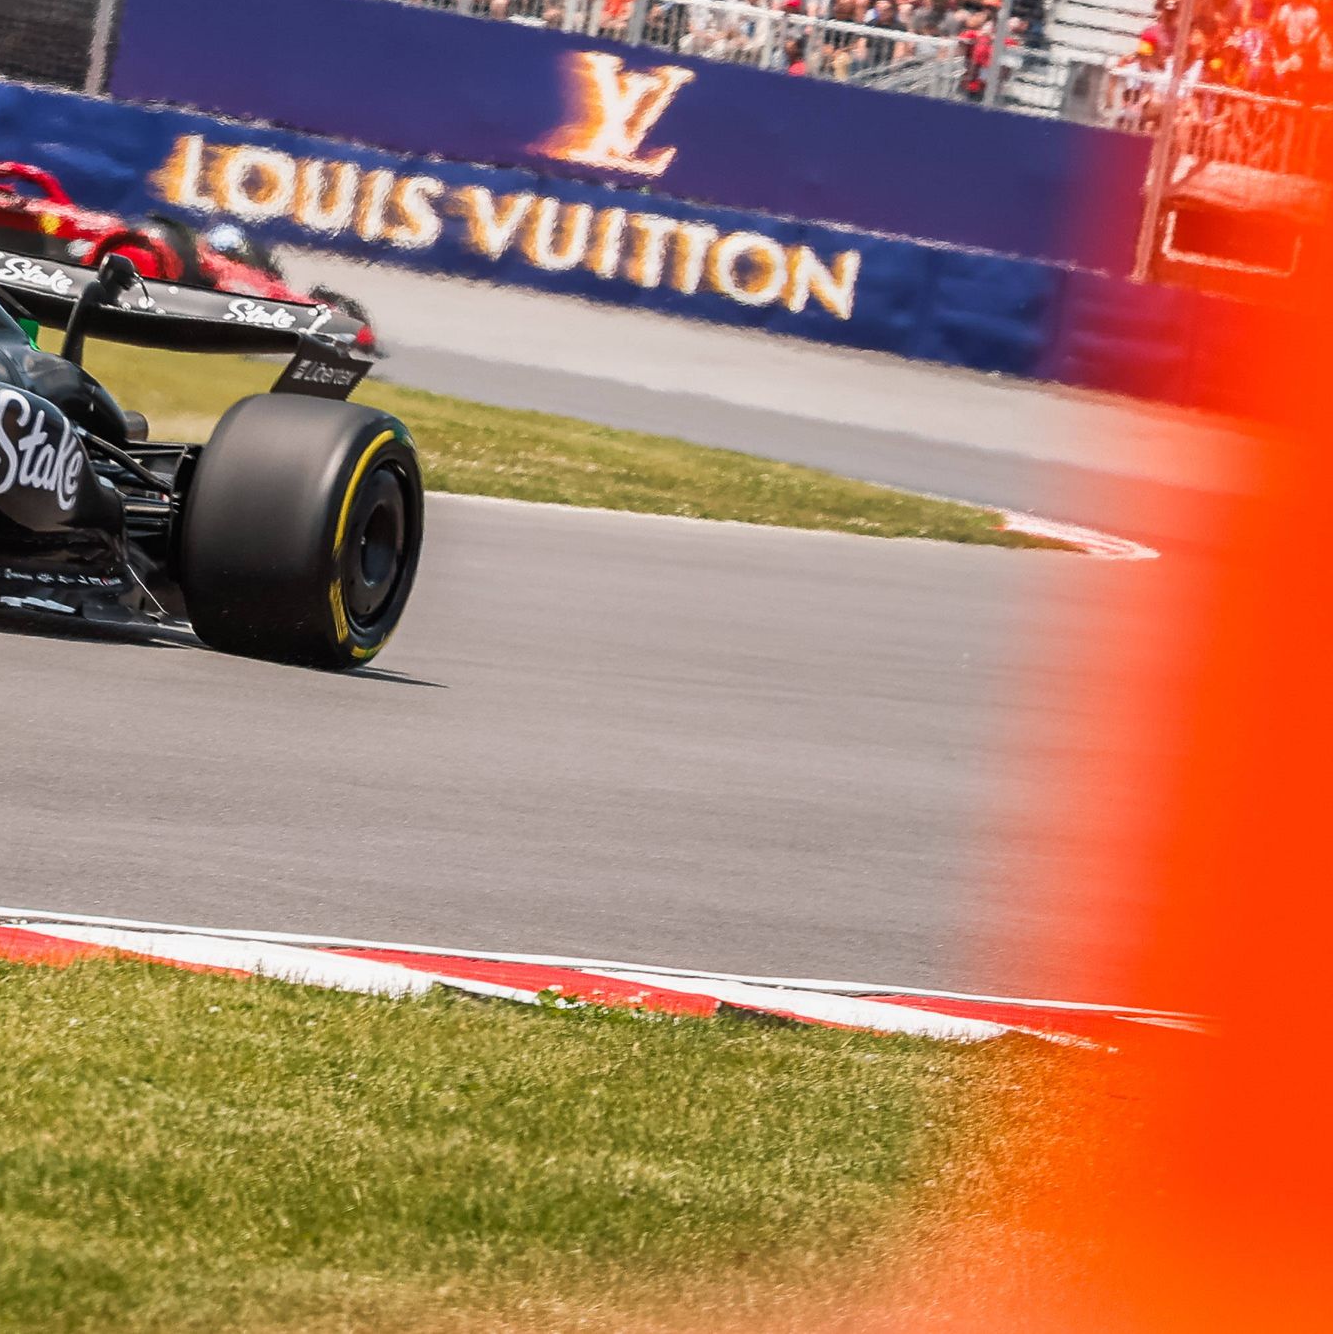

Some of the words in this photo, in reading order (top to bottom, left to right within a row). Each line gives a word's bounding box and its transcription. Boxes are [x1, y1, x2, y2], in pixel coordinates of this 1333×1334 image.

[165, 133, 447, 251] LOUIS
[460, 186, 864, 320] VUITTON
[222, 299, 296, 329] Stake
